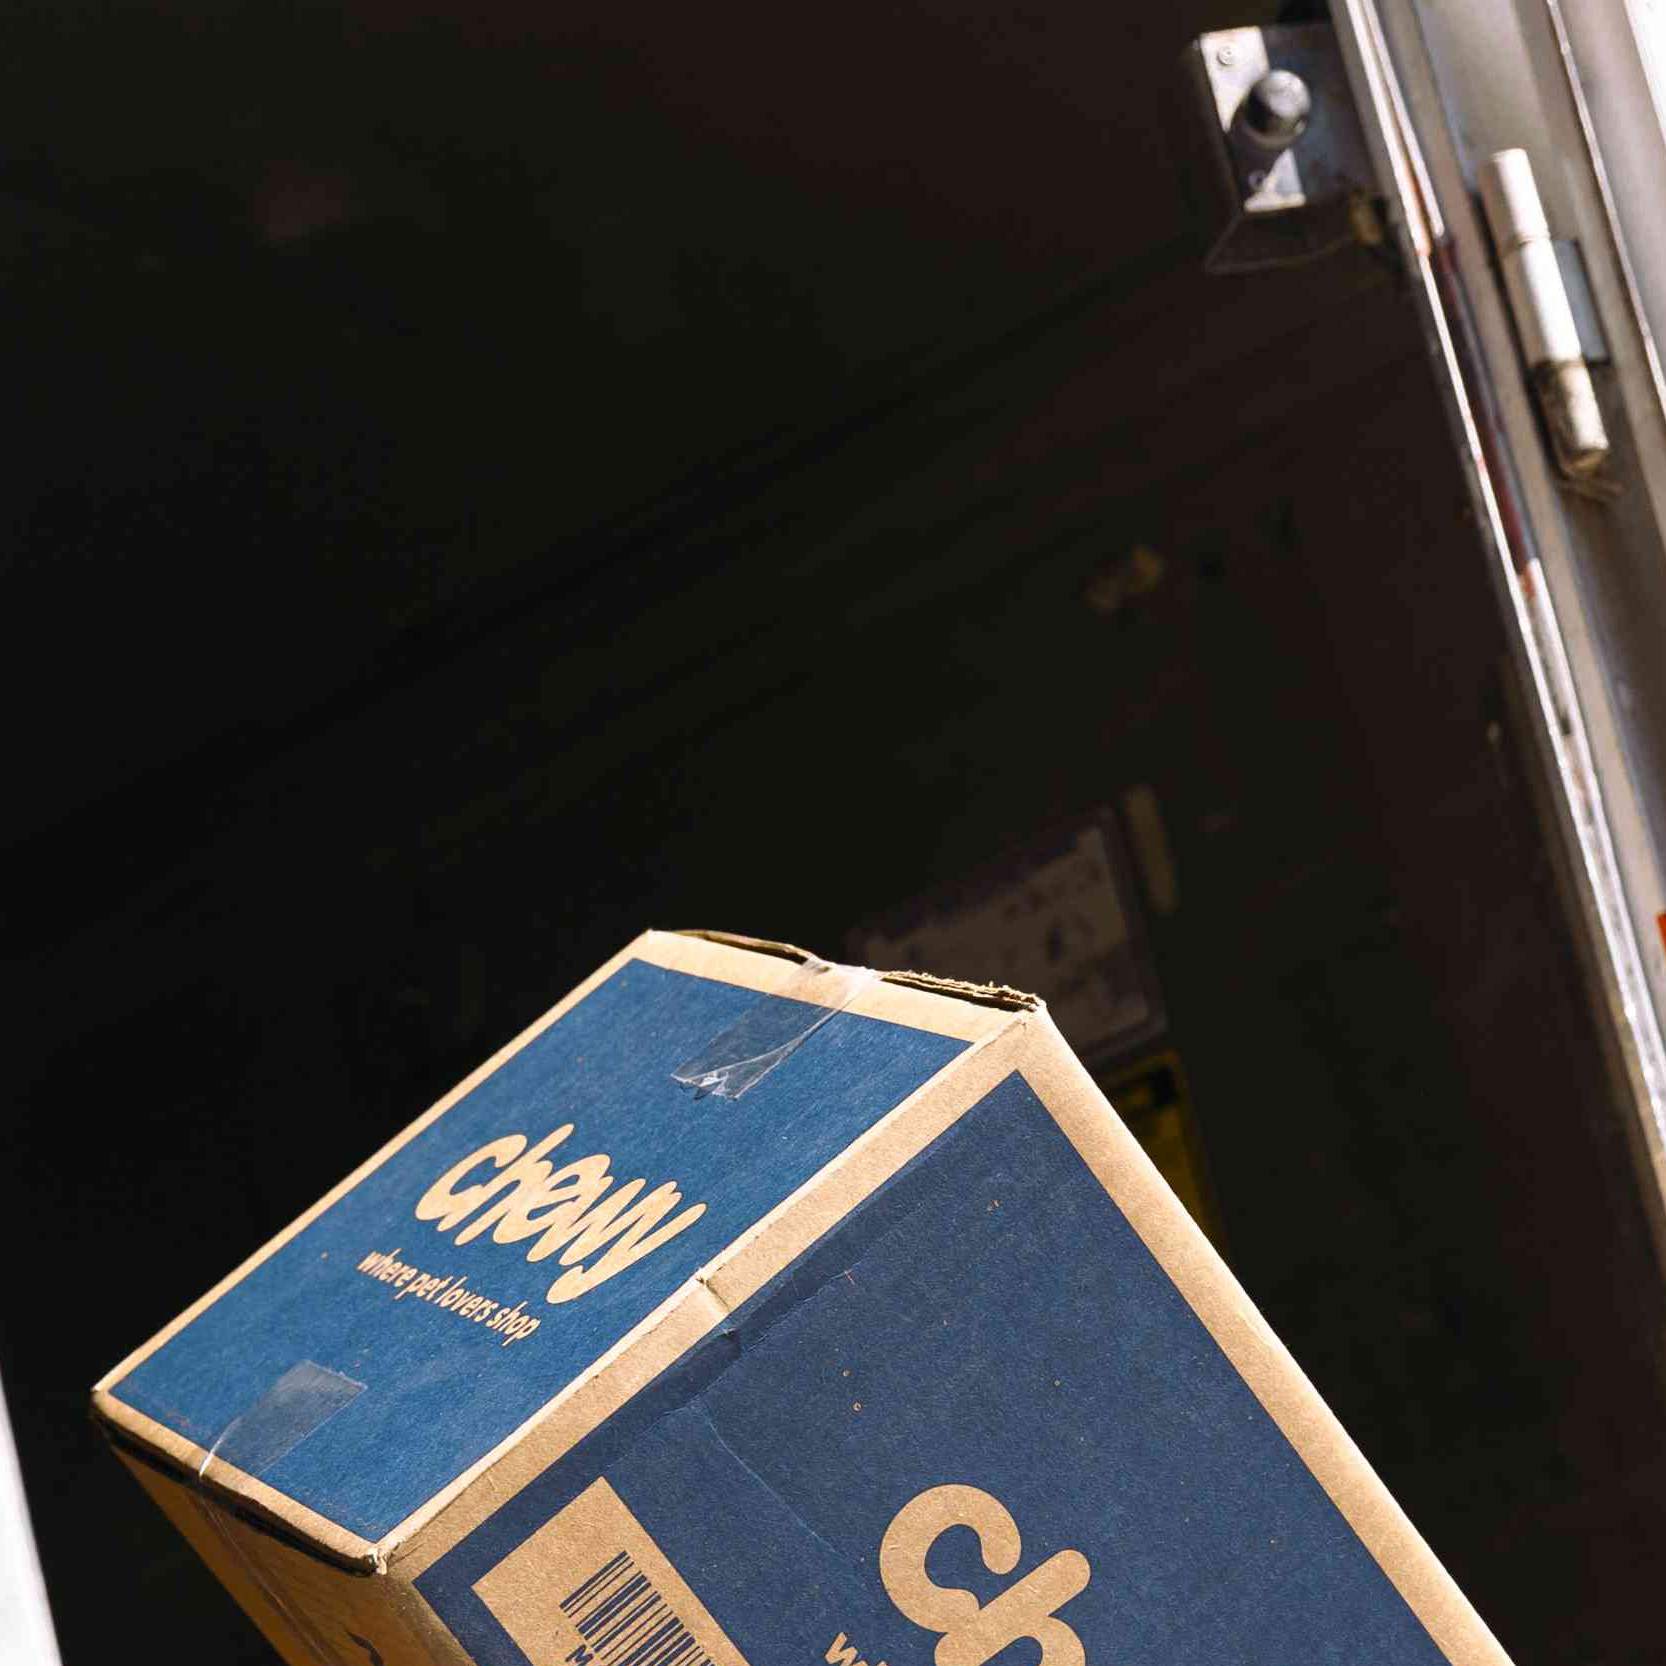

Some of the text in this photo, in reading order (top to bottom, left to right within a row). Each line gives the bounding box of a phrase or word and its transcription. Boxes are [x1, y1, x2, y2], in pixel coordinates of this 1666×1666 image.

[414, 1122, 708, 1305] chewy
[356, 1247, 542, 1347] where pet lovers shop
